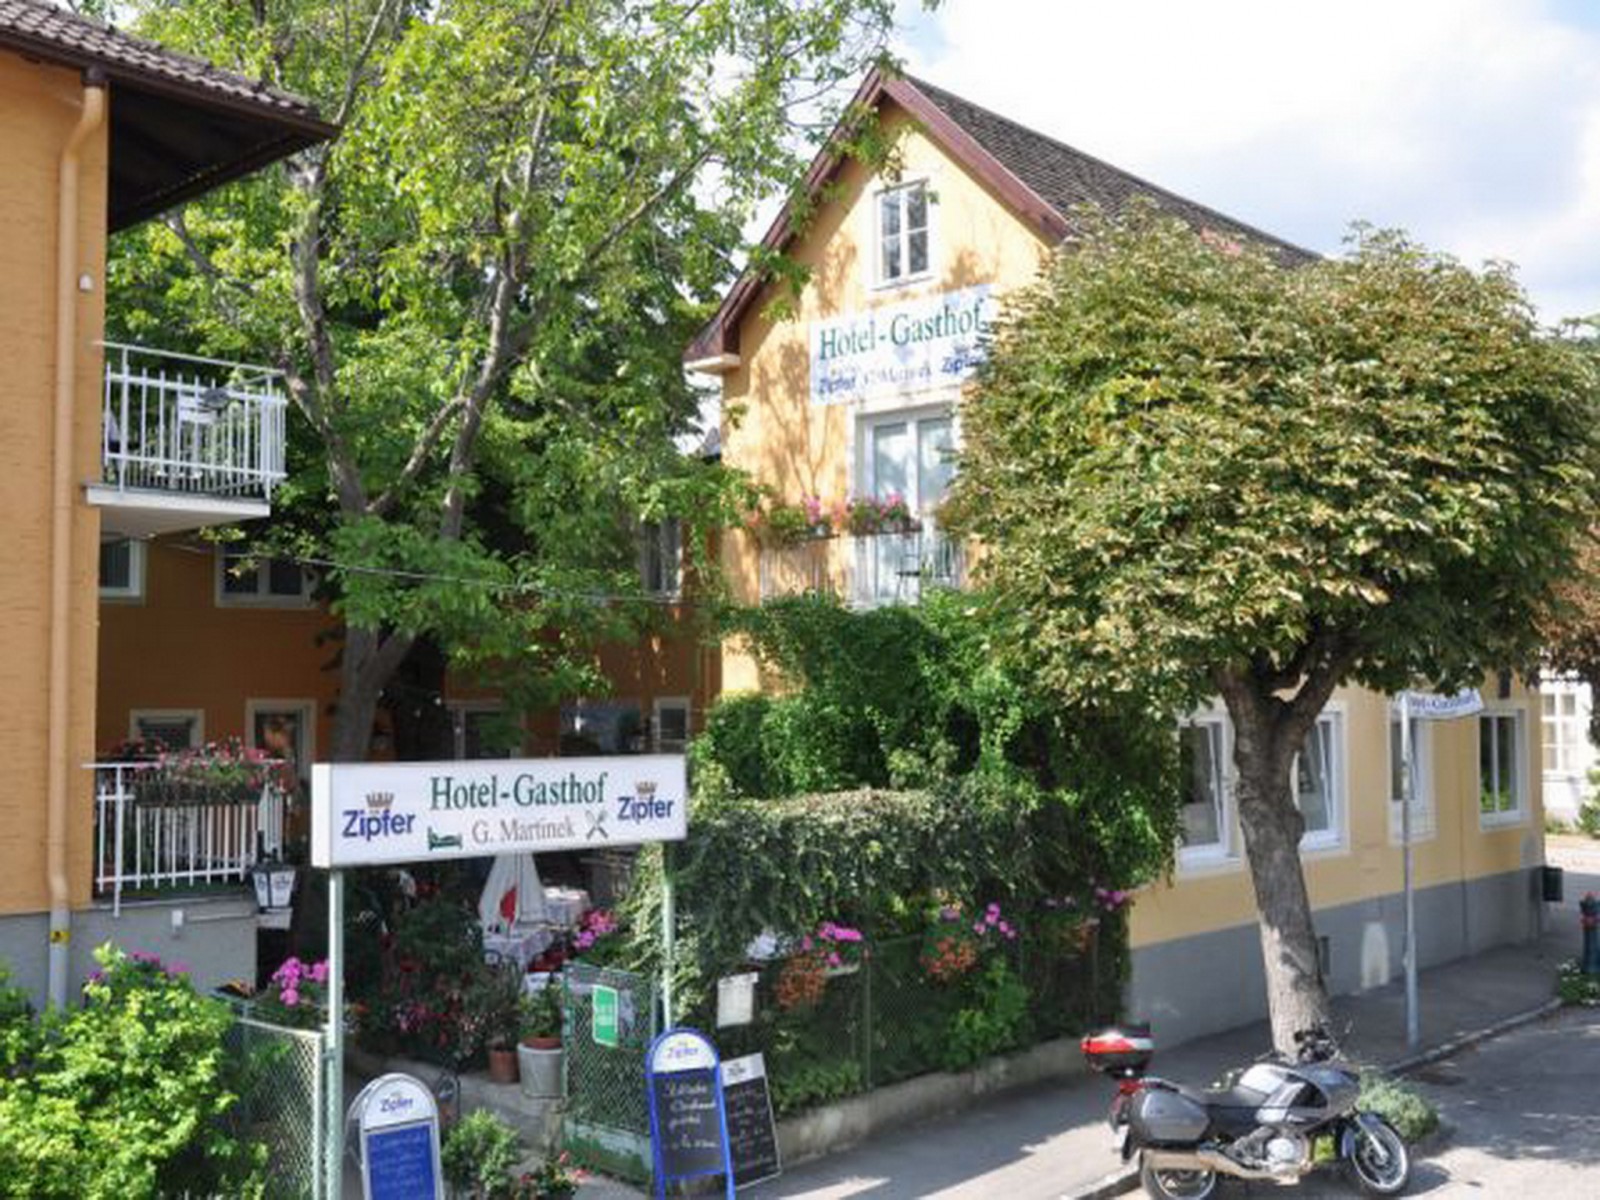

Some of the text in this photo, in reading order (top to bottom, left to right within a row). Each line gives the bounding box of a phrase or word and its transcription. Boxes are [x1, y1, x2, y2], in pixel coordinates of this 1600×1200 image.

[430, 772, 609, 811] Hotel-Gasthof
[342, 809, 416, 842] Zipfer
[617, 796, 674, 825] Zipfer
[471, 815, 576, 845] G. Martinek
